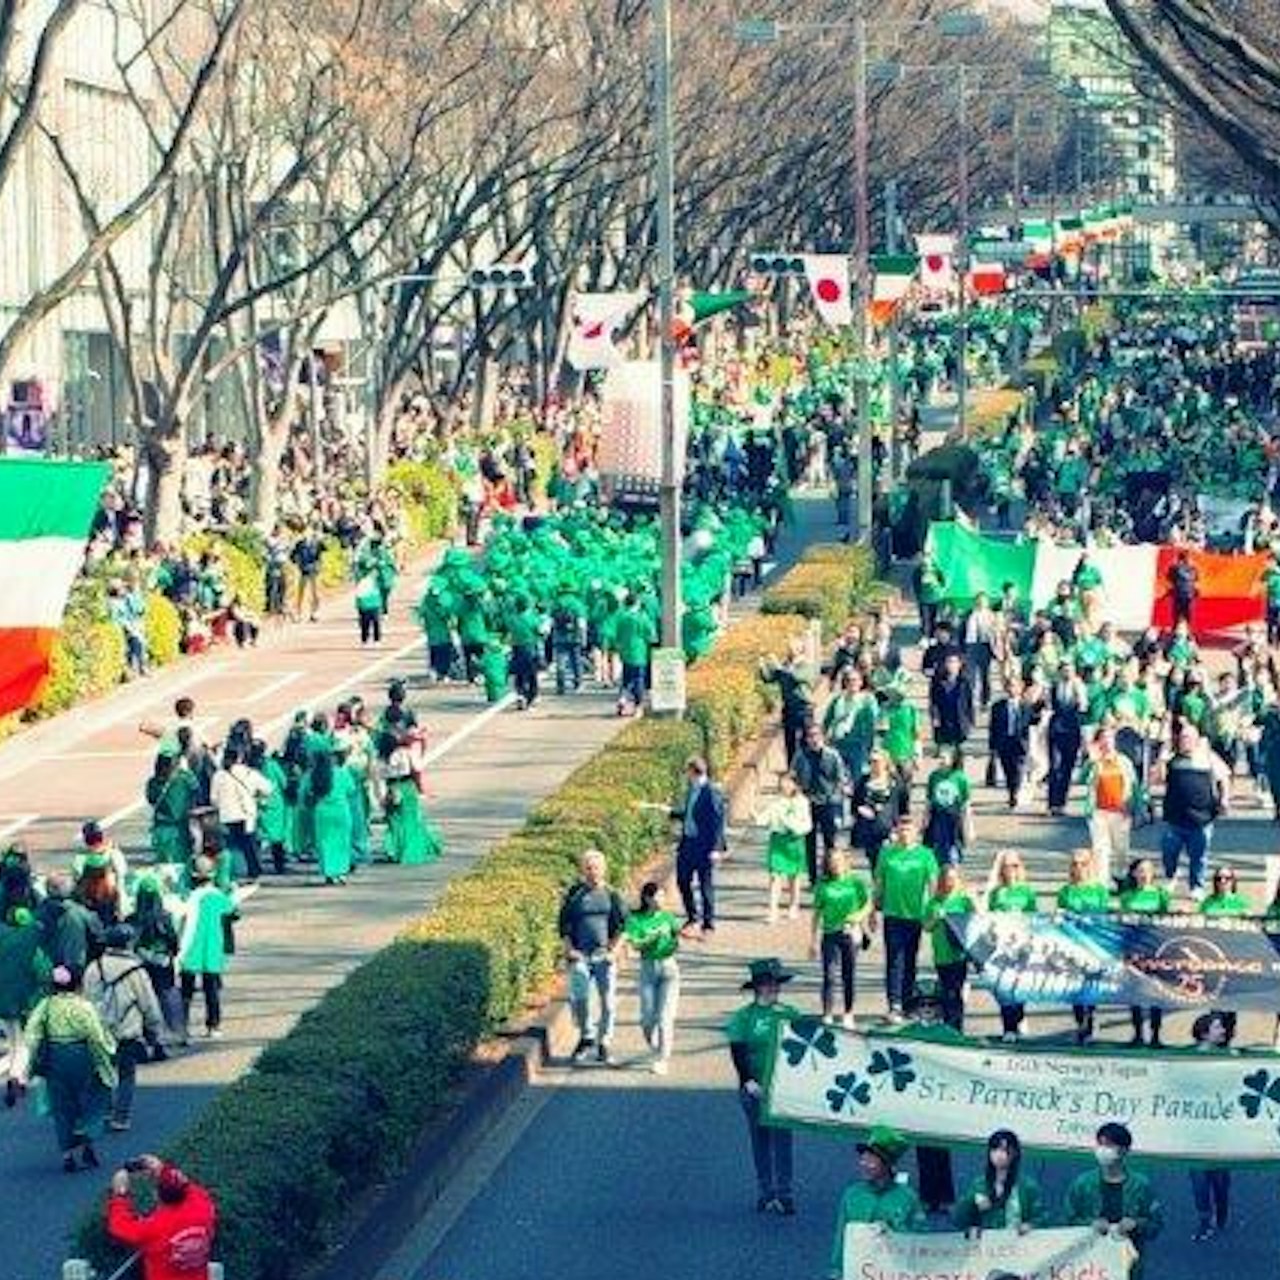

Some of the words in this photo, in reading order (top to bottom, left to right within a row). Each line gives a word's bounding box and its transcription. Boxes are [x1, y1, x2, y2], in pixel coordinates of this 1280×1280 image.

[1045, 1060, 1105, 1076] Network
[1110, 1062, 1148, 1080] Japan
[1150, 1092, 1237, 1121] Parade
